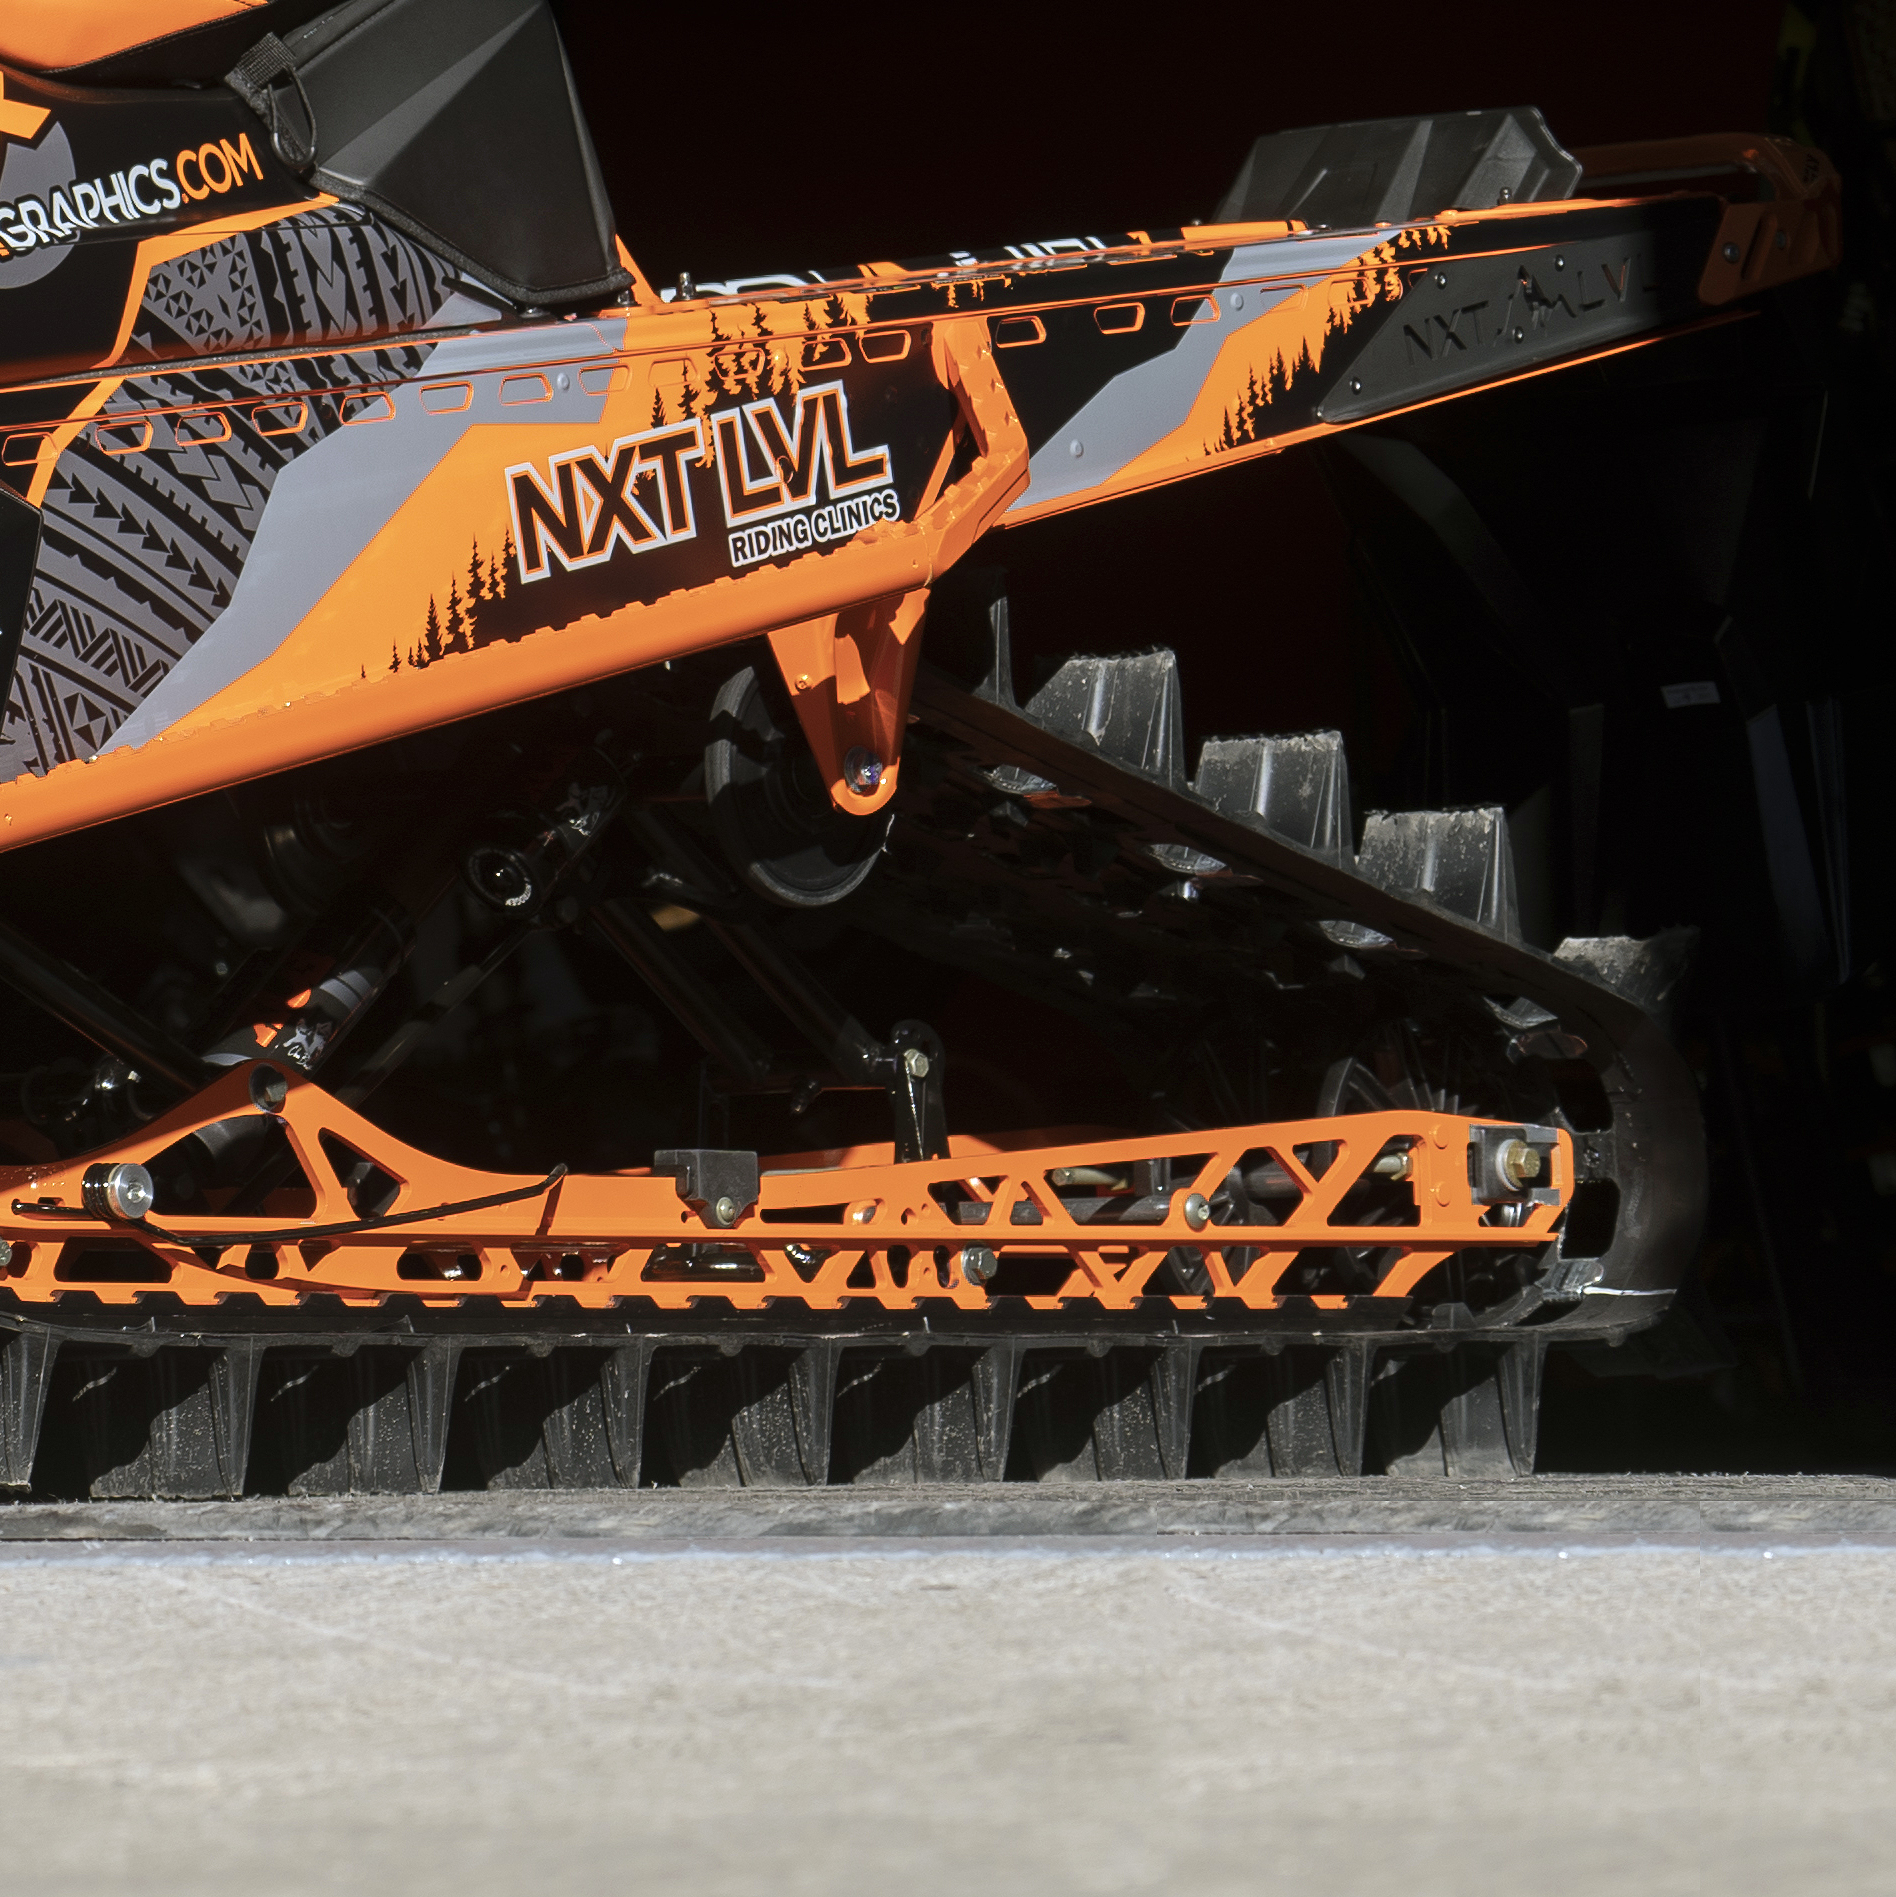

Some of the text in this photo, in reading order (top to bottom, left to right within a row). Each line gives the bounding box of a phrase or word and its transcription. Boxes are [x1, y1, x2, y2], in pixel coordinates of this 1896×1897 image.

[502, 379, 895, 585] NXT LVL
[726, 488, 902, 568] RIDING CLINICS
